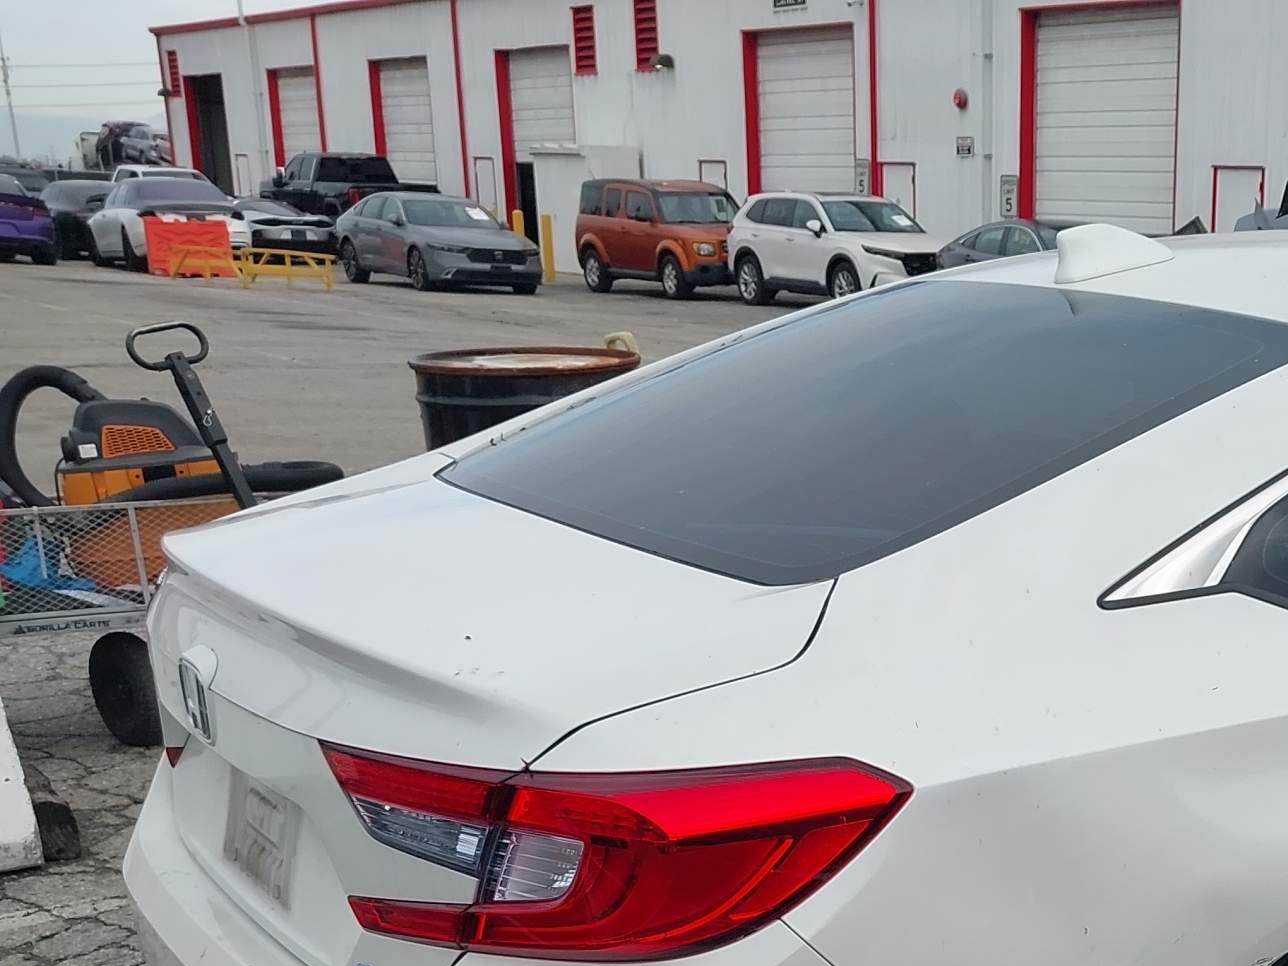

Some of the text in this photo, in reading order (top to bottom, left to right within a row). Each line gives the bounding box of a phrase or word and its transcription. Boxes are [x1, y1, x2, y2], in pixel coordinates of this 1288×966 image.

[858, 179, 865, 193] 5
[1005, 197, 1013, 212] 5
[74, 620, 110, 630] CARTS
